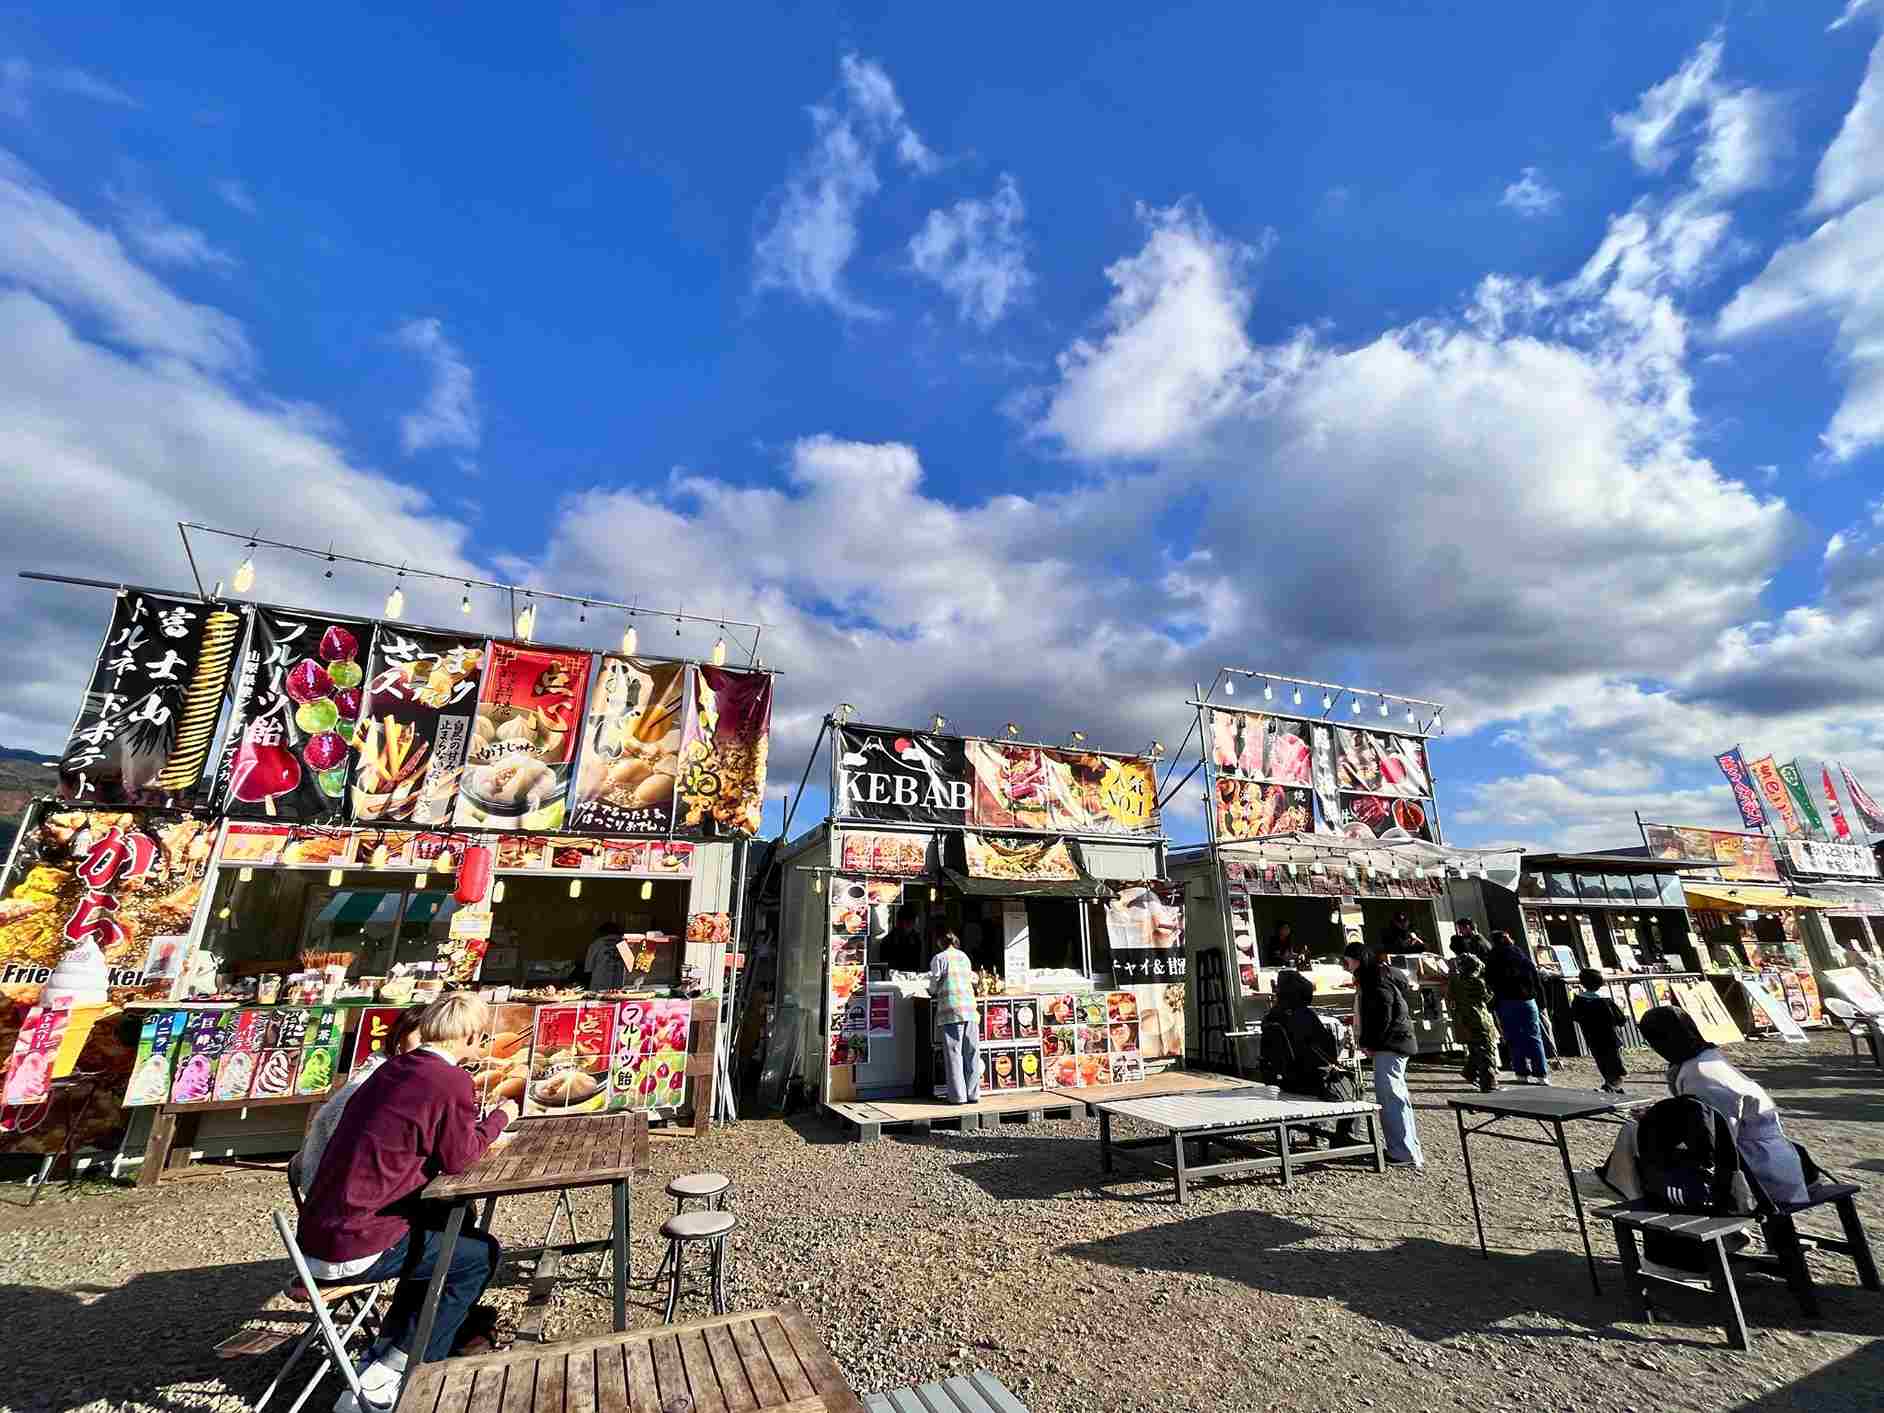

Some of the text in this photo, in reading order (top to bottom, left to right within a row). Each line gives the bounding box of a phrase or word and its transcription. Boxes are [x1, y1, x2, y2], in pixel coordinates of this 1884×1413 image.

[249, 619, 309, 747] フルーツ飴
[381, 636, 483, 676] さつま
[68, 597, 150, 800] トルネードポテト
[838, 769, 973, 812] KEBAB
[2, 963, 56, 984] Frie
[616, 1006, 641, 1087] フルーツ飴
